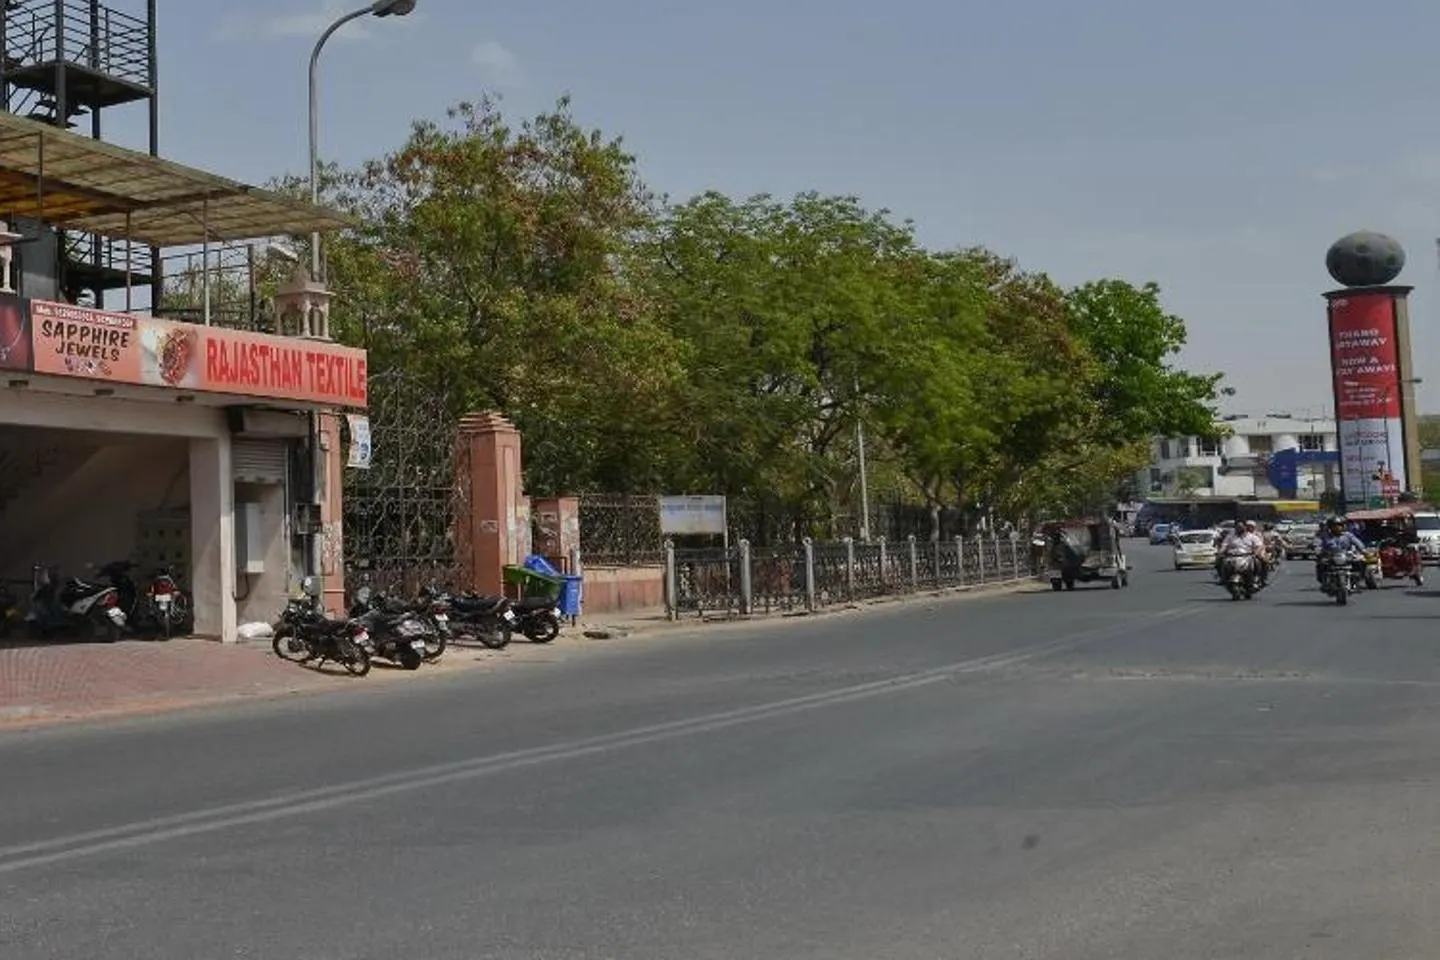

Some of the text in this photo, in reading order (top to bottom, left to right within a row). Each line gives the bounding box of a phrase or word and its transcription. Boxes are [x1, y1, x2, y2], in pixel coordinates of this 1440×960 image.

[42, 319, 130, 349] SAPPHIRE
[55, 341, 120, 362] JEWELS
[206, 337, 367, 401] RAJASTHAN TEXTILE
